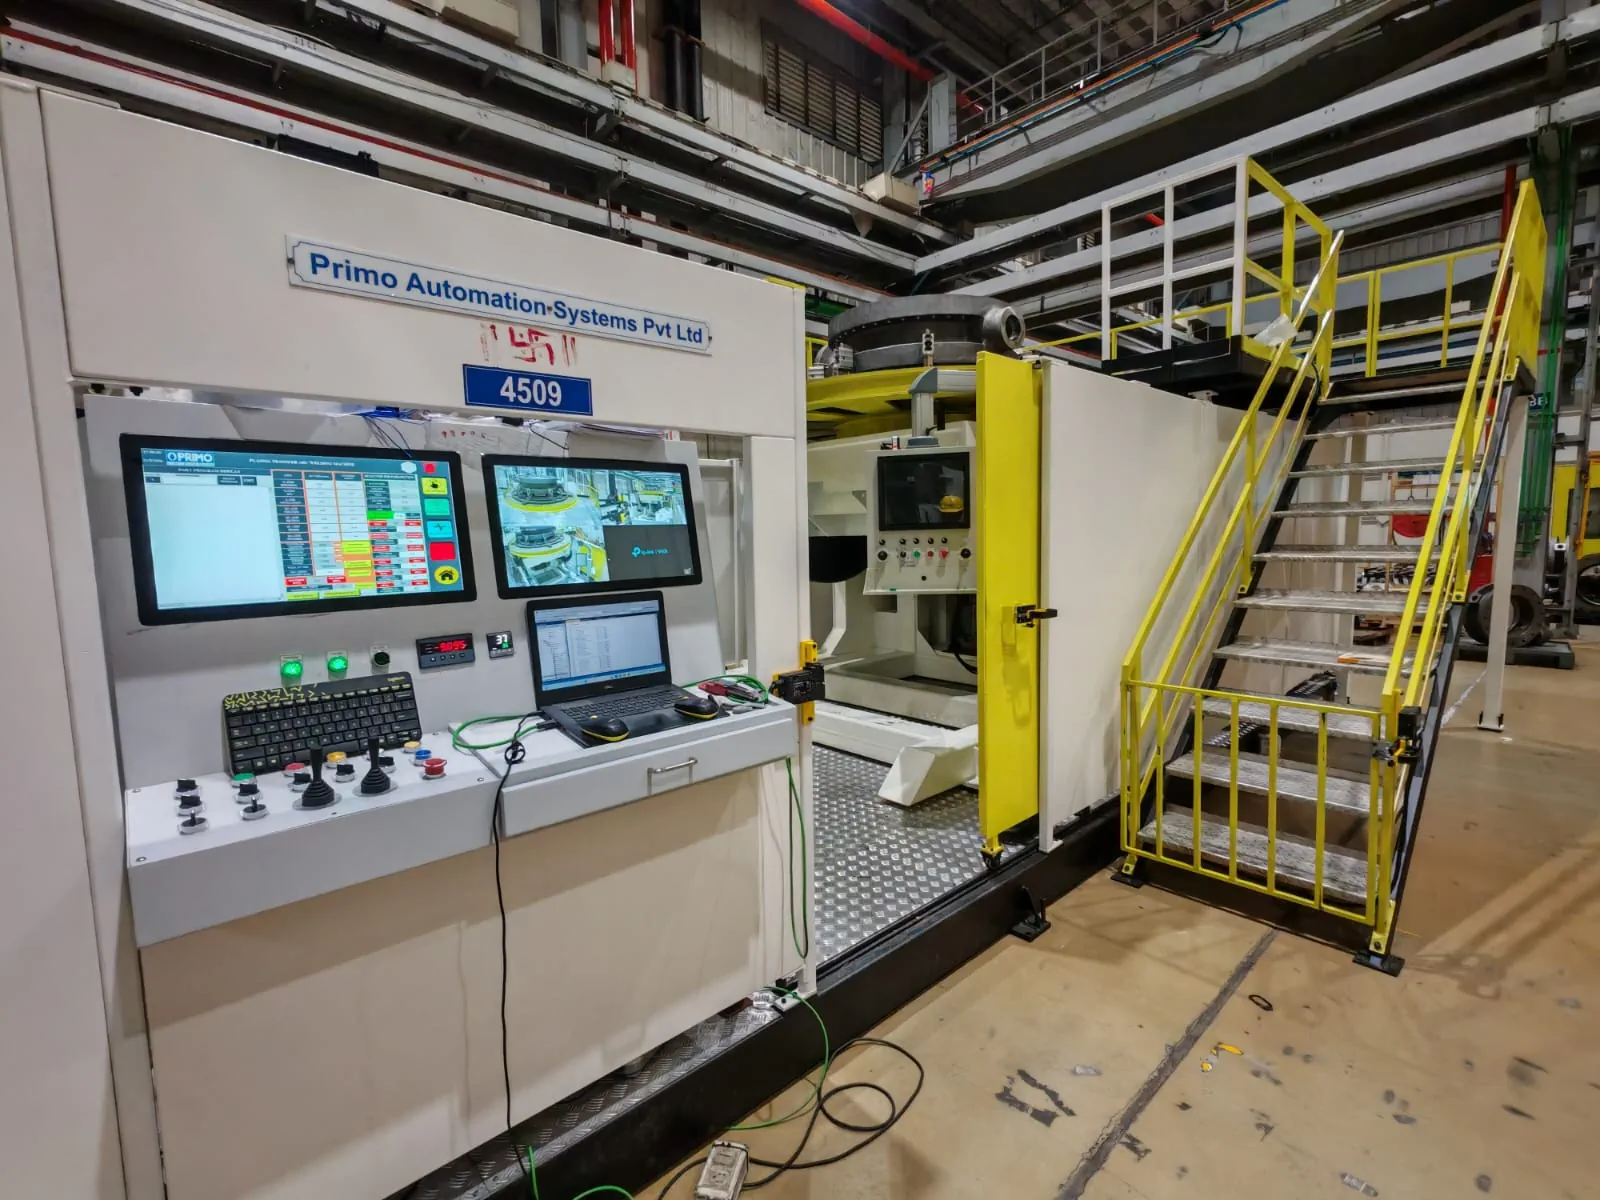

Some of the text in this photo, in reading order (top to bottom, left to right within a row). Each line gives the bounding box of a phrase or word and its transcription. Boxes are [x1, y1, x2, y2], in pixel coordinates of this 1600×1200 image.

[310, 252, 703, 344] Primo Automation Systems Pvt Ltd
[499, 376, 562, 407] 4509
